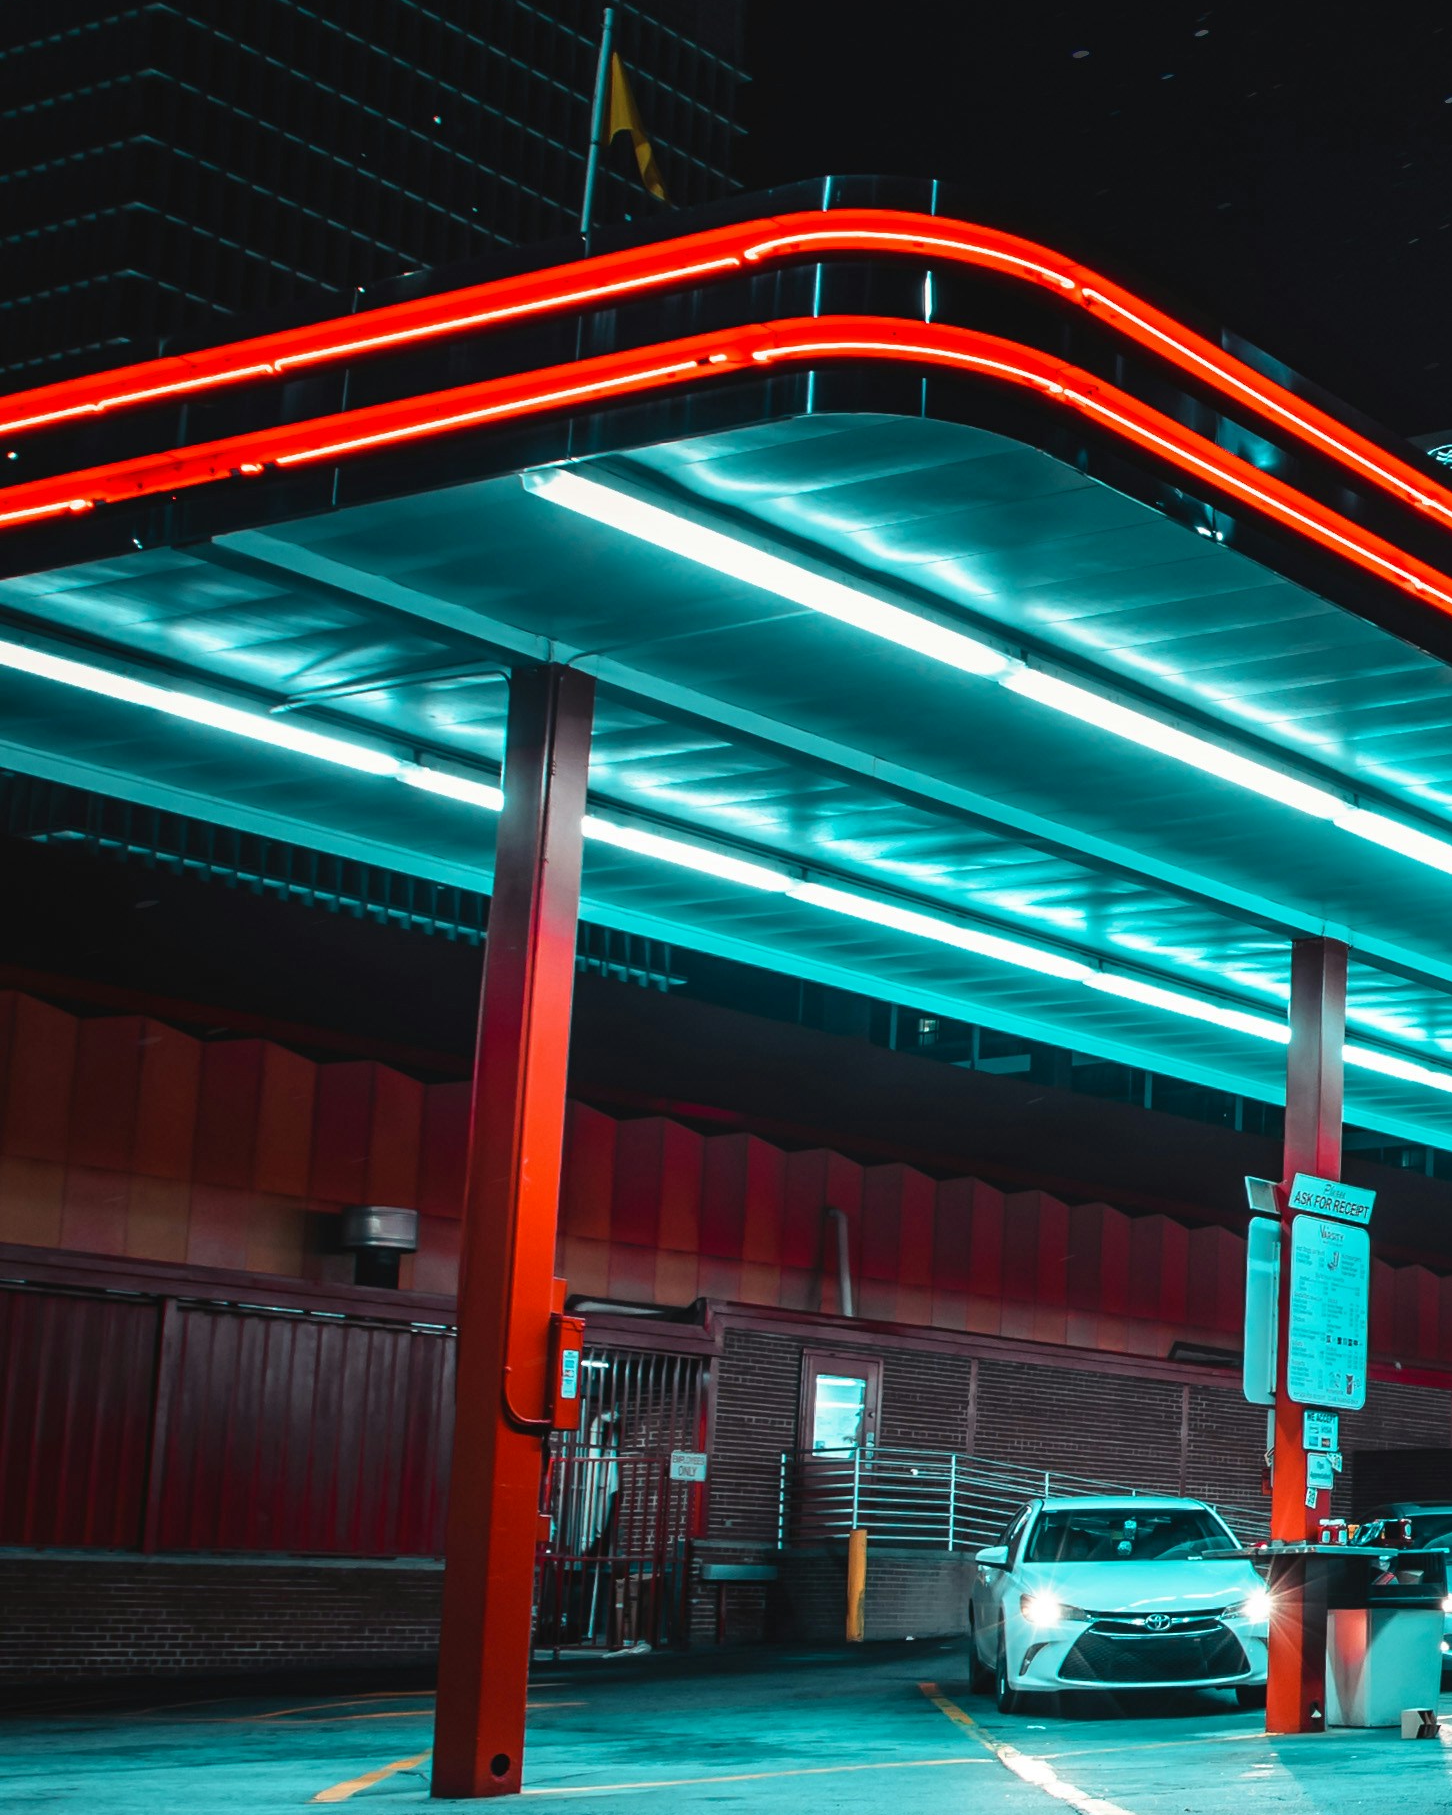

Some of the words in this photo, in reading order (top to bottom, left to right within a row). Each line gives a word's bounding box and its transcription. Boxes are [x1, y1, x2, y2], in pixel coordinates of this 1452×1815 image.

[1294, 1191, 1314, 1207] ASK
[1314, 1193, 1333, 1211] FOR
[1333, 1199, 1370, 1219] RECEIPT
[679, 1465, 696, 1476] ONLY
